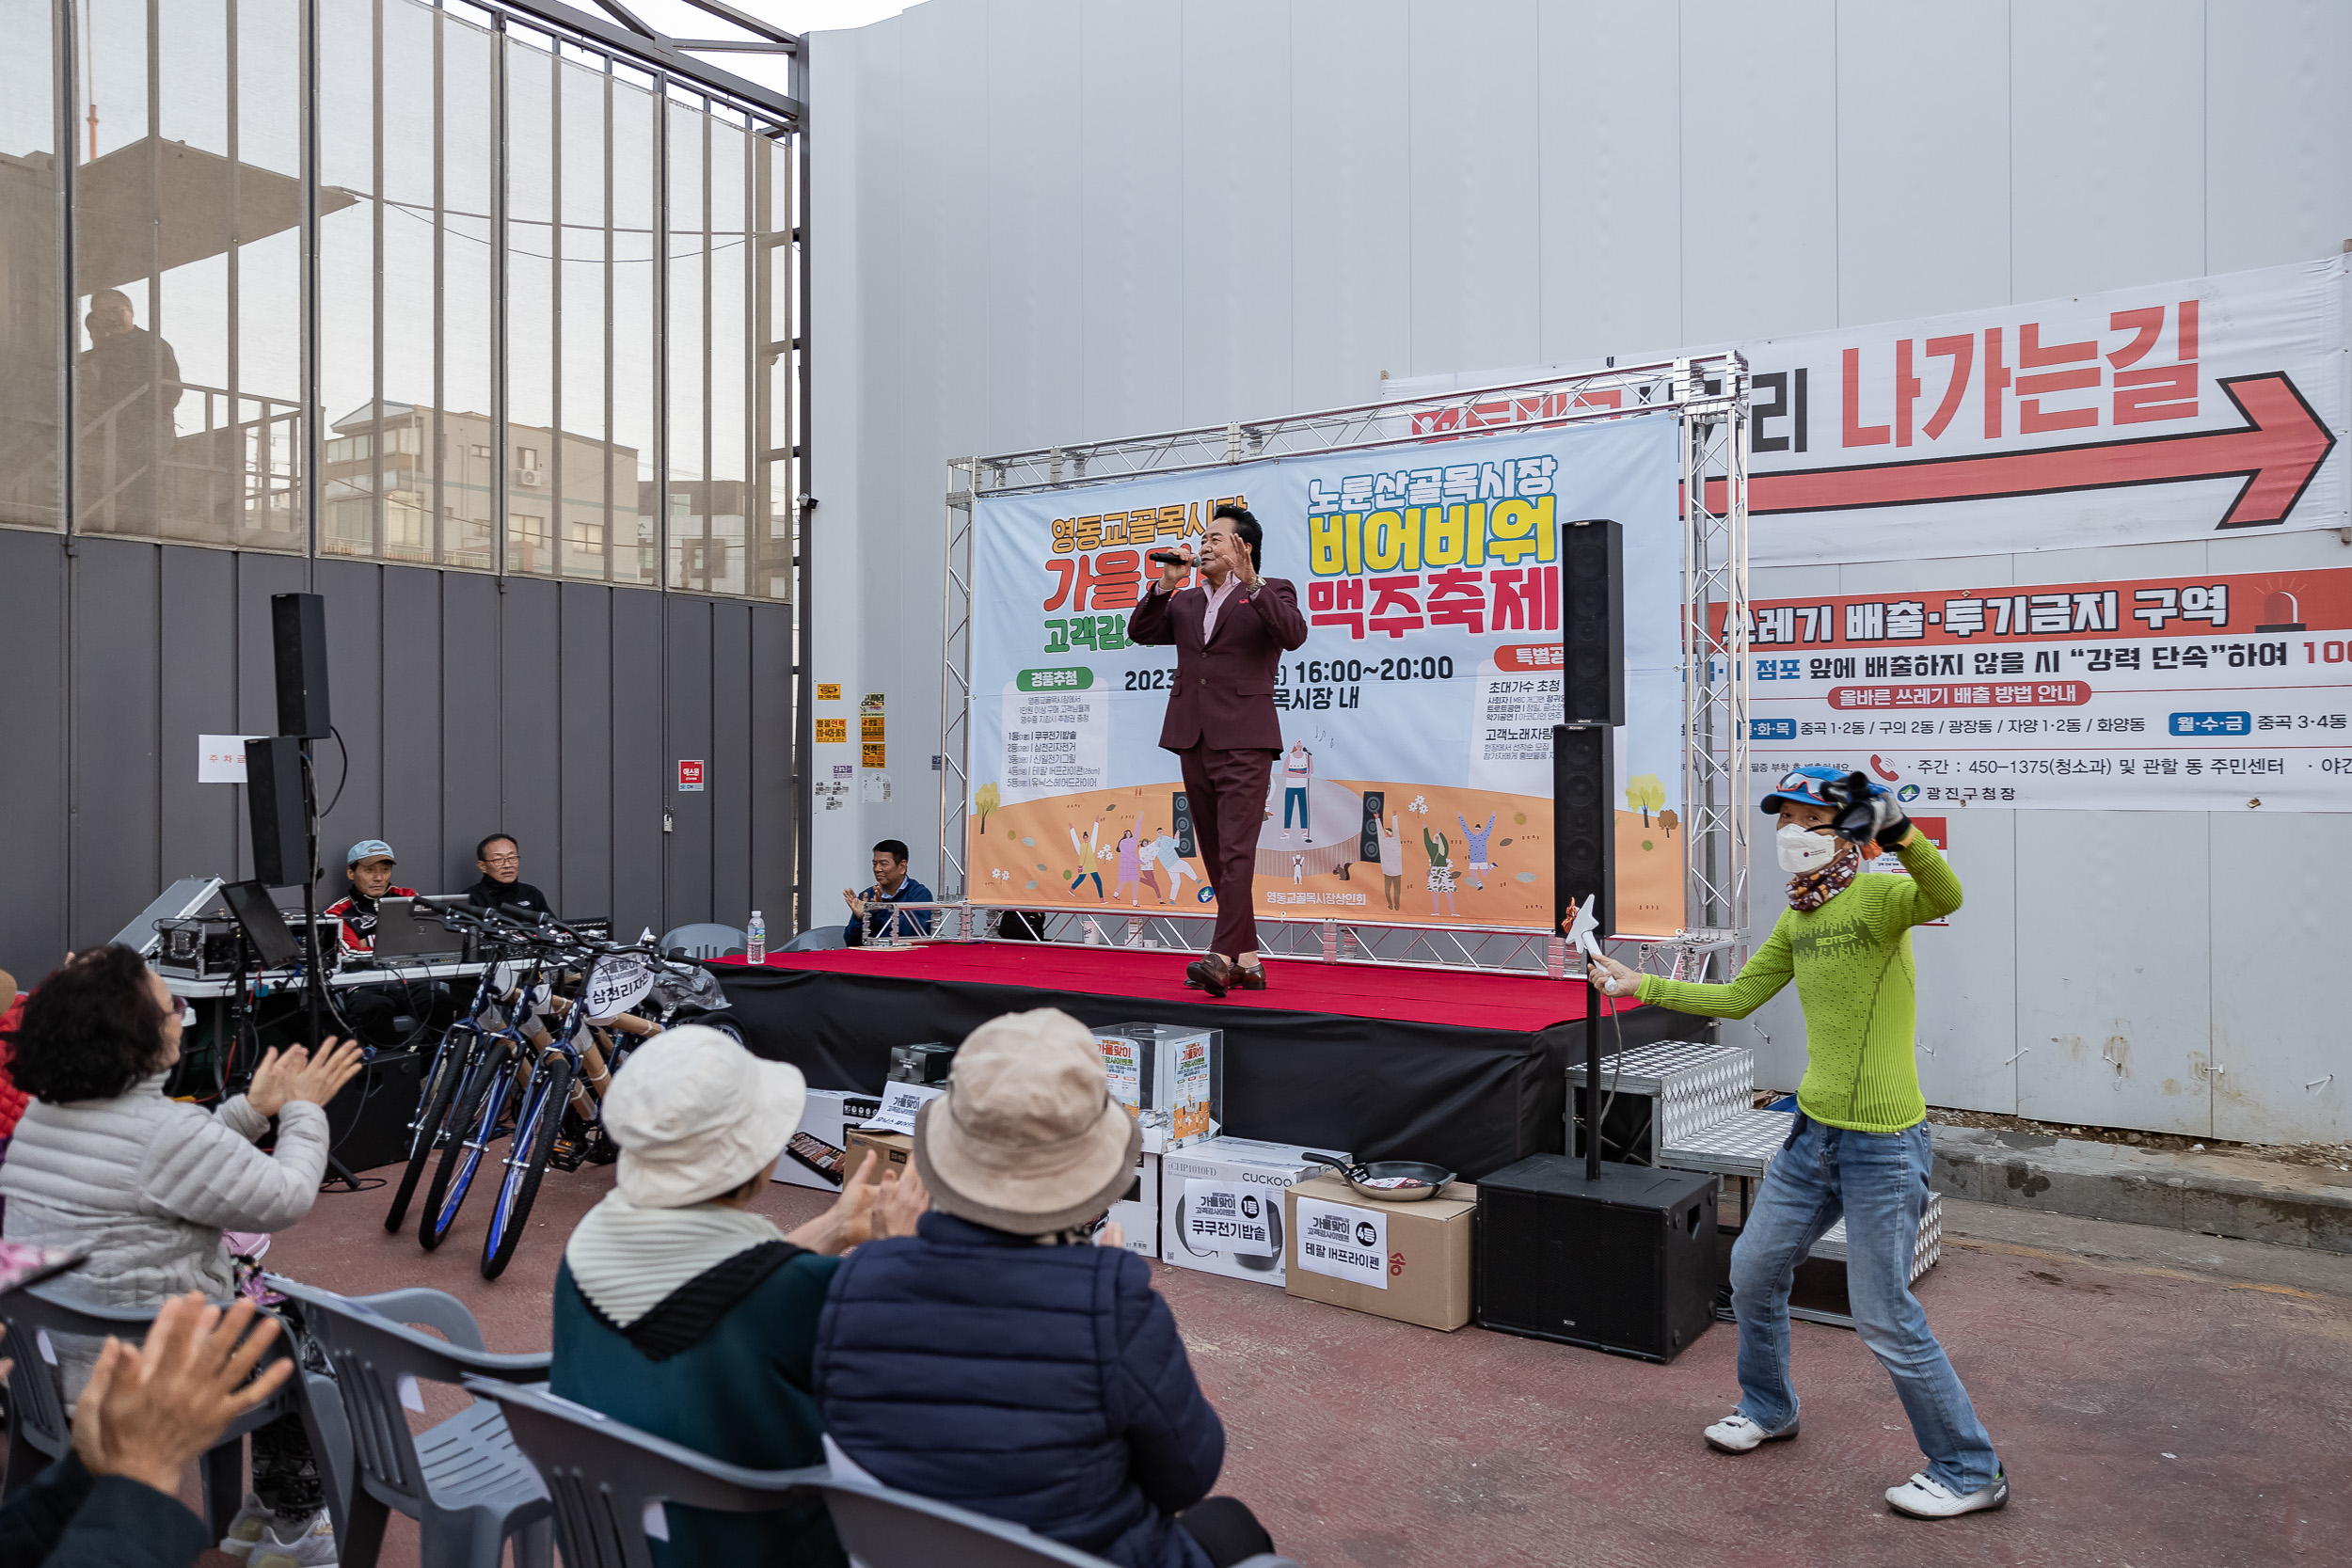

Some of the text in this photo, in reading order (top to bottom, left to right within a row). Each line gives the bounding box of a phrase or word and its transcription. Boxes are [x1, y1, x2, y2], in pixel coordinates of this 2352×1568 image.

[1842, 300, 2199, 448] 나가는길
[1308, 454, 1557, 515] 노룬산골목시장
[1309, 492, 1557, 576] 비어비워
[1308, 566, 1558, 640] 맥주축제
[1845, 590, 2119, 641] 배출·투기금지
[2133, 584, 2229, 631] 구역
[1295, 655, 1454, 684] 16:00~20:00
[1756, 658, 1801, 680] 점포
[1810, 657, 1855, 679] 앞에
[1865, 653, 1964, 679] 배출하지
[1974, 651, 2025, 674] 않을
[2034, 650, 2060, 673] 시
[2303, 640, 2352, 664] 10
[1031, 671, 1078, 686] 경품추첨
[1488, 679, 1560, 693] 초대가수 초청
[1339, 685, 1360, 709] 내
[1839, 684, 2076, 706] 올바른 쓰레기 배출 방법 안내
[1035, 730, 1077, 741] 쿠쿠전기밥솥
[1800, 721, 1828, 736] 중곡
[1879, 721, 1906, 735] 구의
[1911, 721, 1934, 735] 2동
[1948, 719, 1993, 734] 광장동
[2008, 719, 2039, 734] 자양
[2097, 717, 2146, 733] 화양동
[2257, 715, 2292, 730] 중곡
[1035, 742, 1076, 752] 삼천리자전거
[1917, 760, 1948, 775] 주간
[2119, 759, 2136, 776] 및
[2142, 758, 2179, 776] 관할
[2185, 758, 2203, 775] 동
[2209, 757, 2284, 776] 주민센터
[1926, 786, 2016, 801] 광진구청장
[1266, 891, 1367, 906] 영동교골목시장상인회
[1242, 1172, 1293, 1188] CUCKOO
[1192, 1219, 1266, 1242] 쿠쿠전기밥솥
[1305, 1242, 1327, 1259] 테팔
